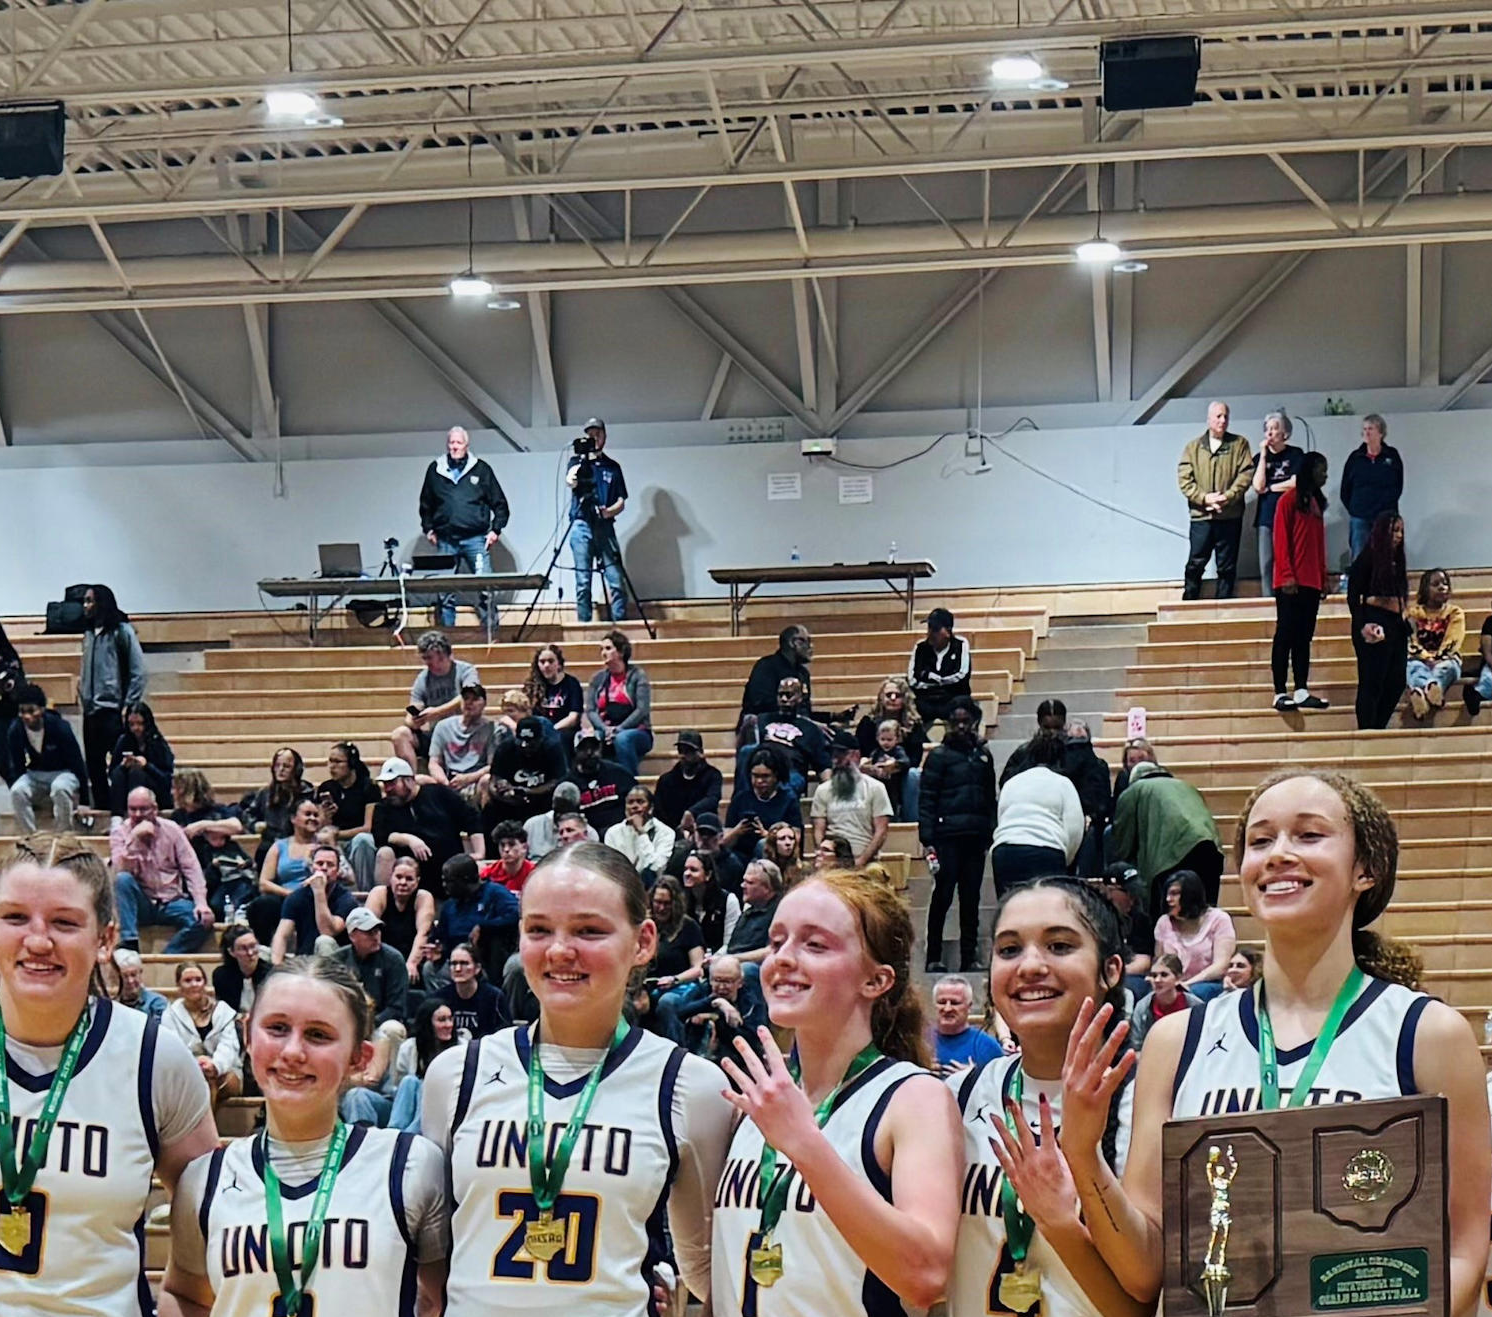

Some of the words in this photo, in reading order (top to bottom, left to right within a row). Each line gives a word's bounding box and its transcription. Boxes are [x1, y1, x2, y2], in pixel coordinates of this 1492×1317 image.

[476, 1120, 632, 1176] UNOTO
[222, 1218, 369, 1278] UNOTO
[489, 1188, 603, 1286] 20
